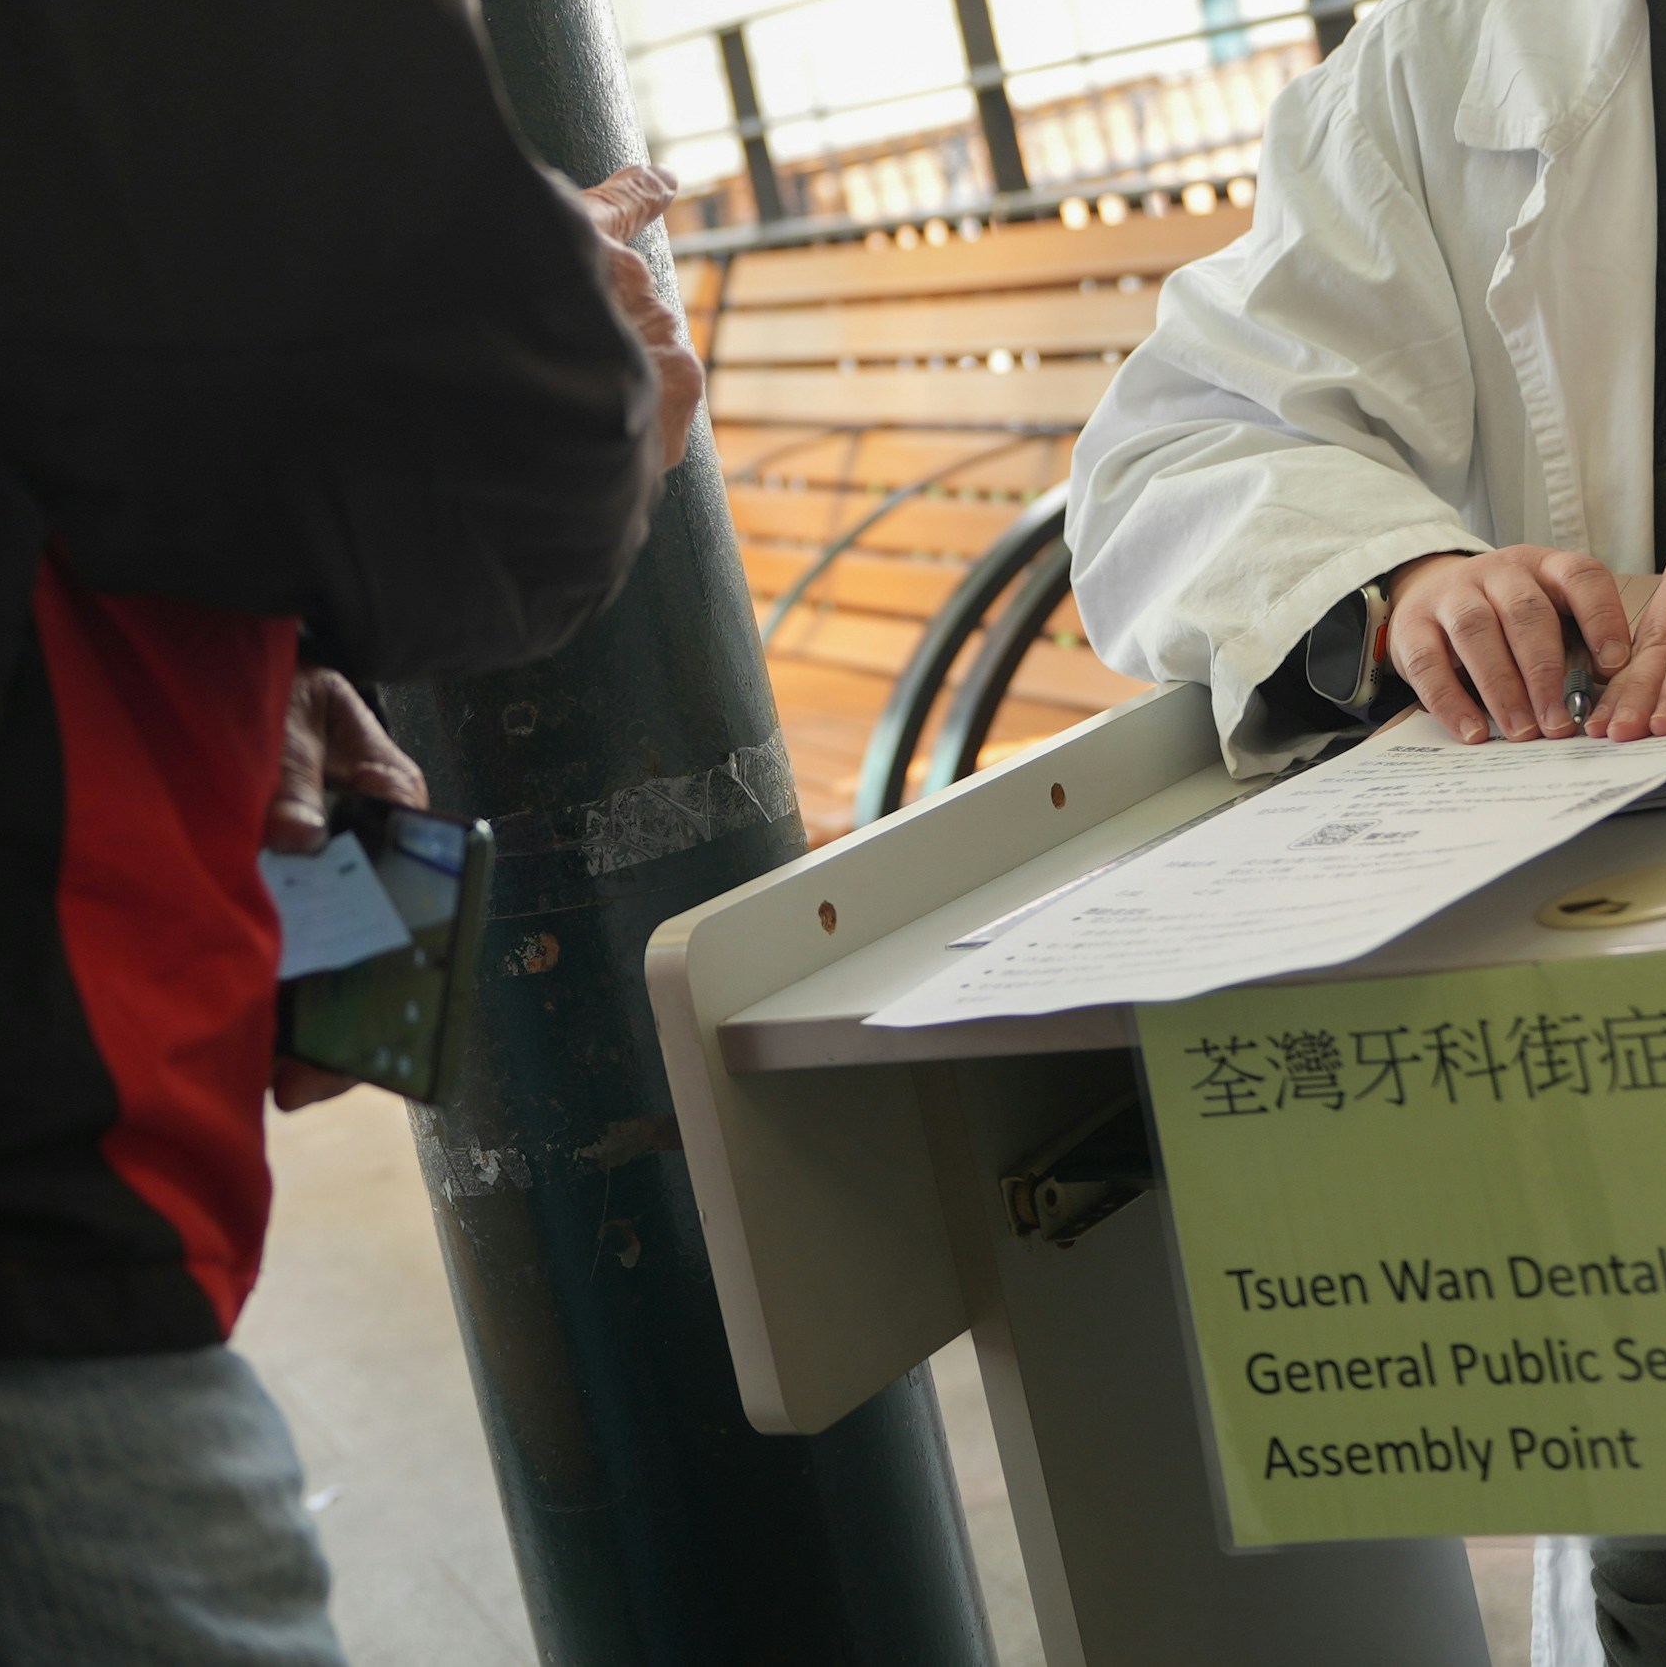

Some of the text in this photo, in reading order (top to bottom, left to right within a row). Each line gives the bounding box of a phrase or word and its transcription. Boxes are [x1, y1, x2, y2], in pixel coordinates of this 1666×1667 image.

[1224, 1267, 1370, 1312] Tsuen
[1379, 1258, 1495, 1303] Wan
[1245, 1340, 1437, 1396] General
[1449, 1337, 1602, 1387] Public
[1264, 1425, 1642, 1483] Assembly Point
